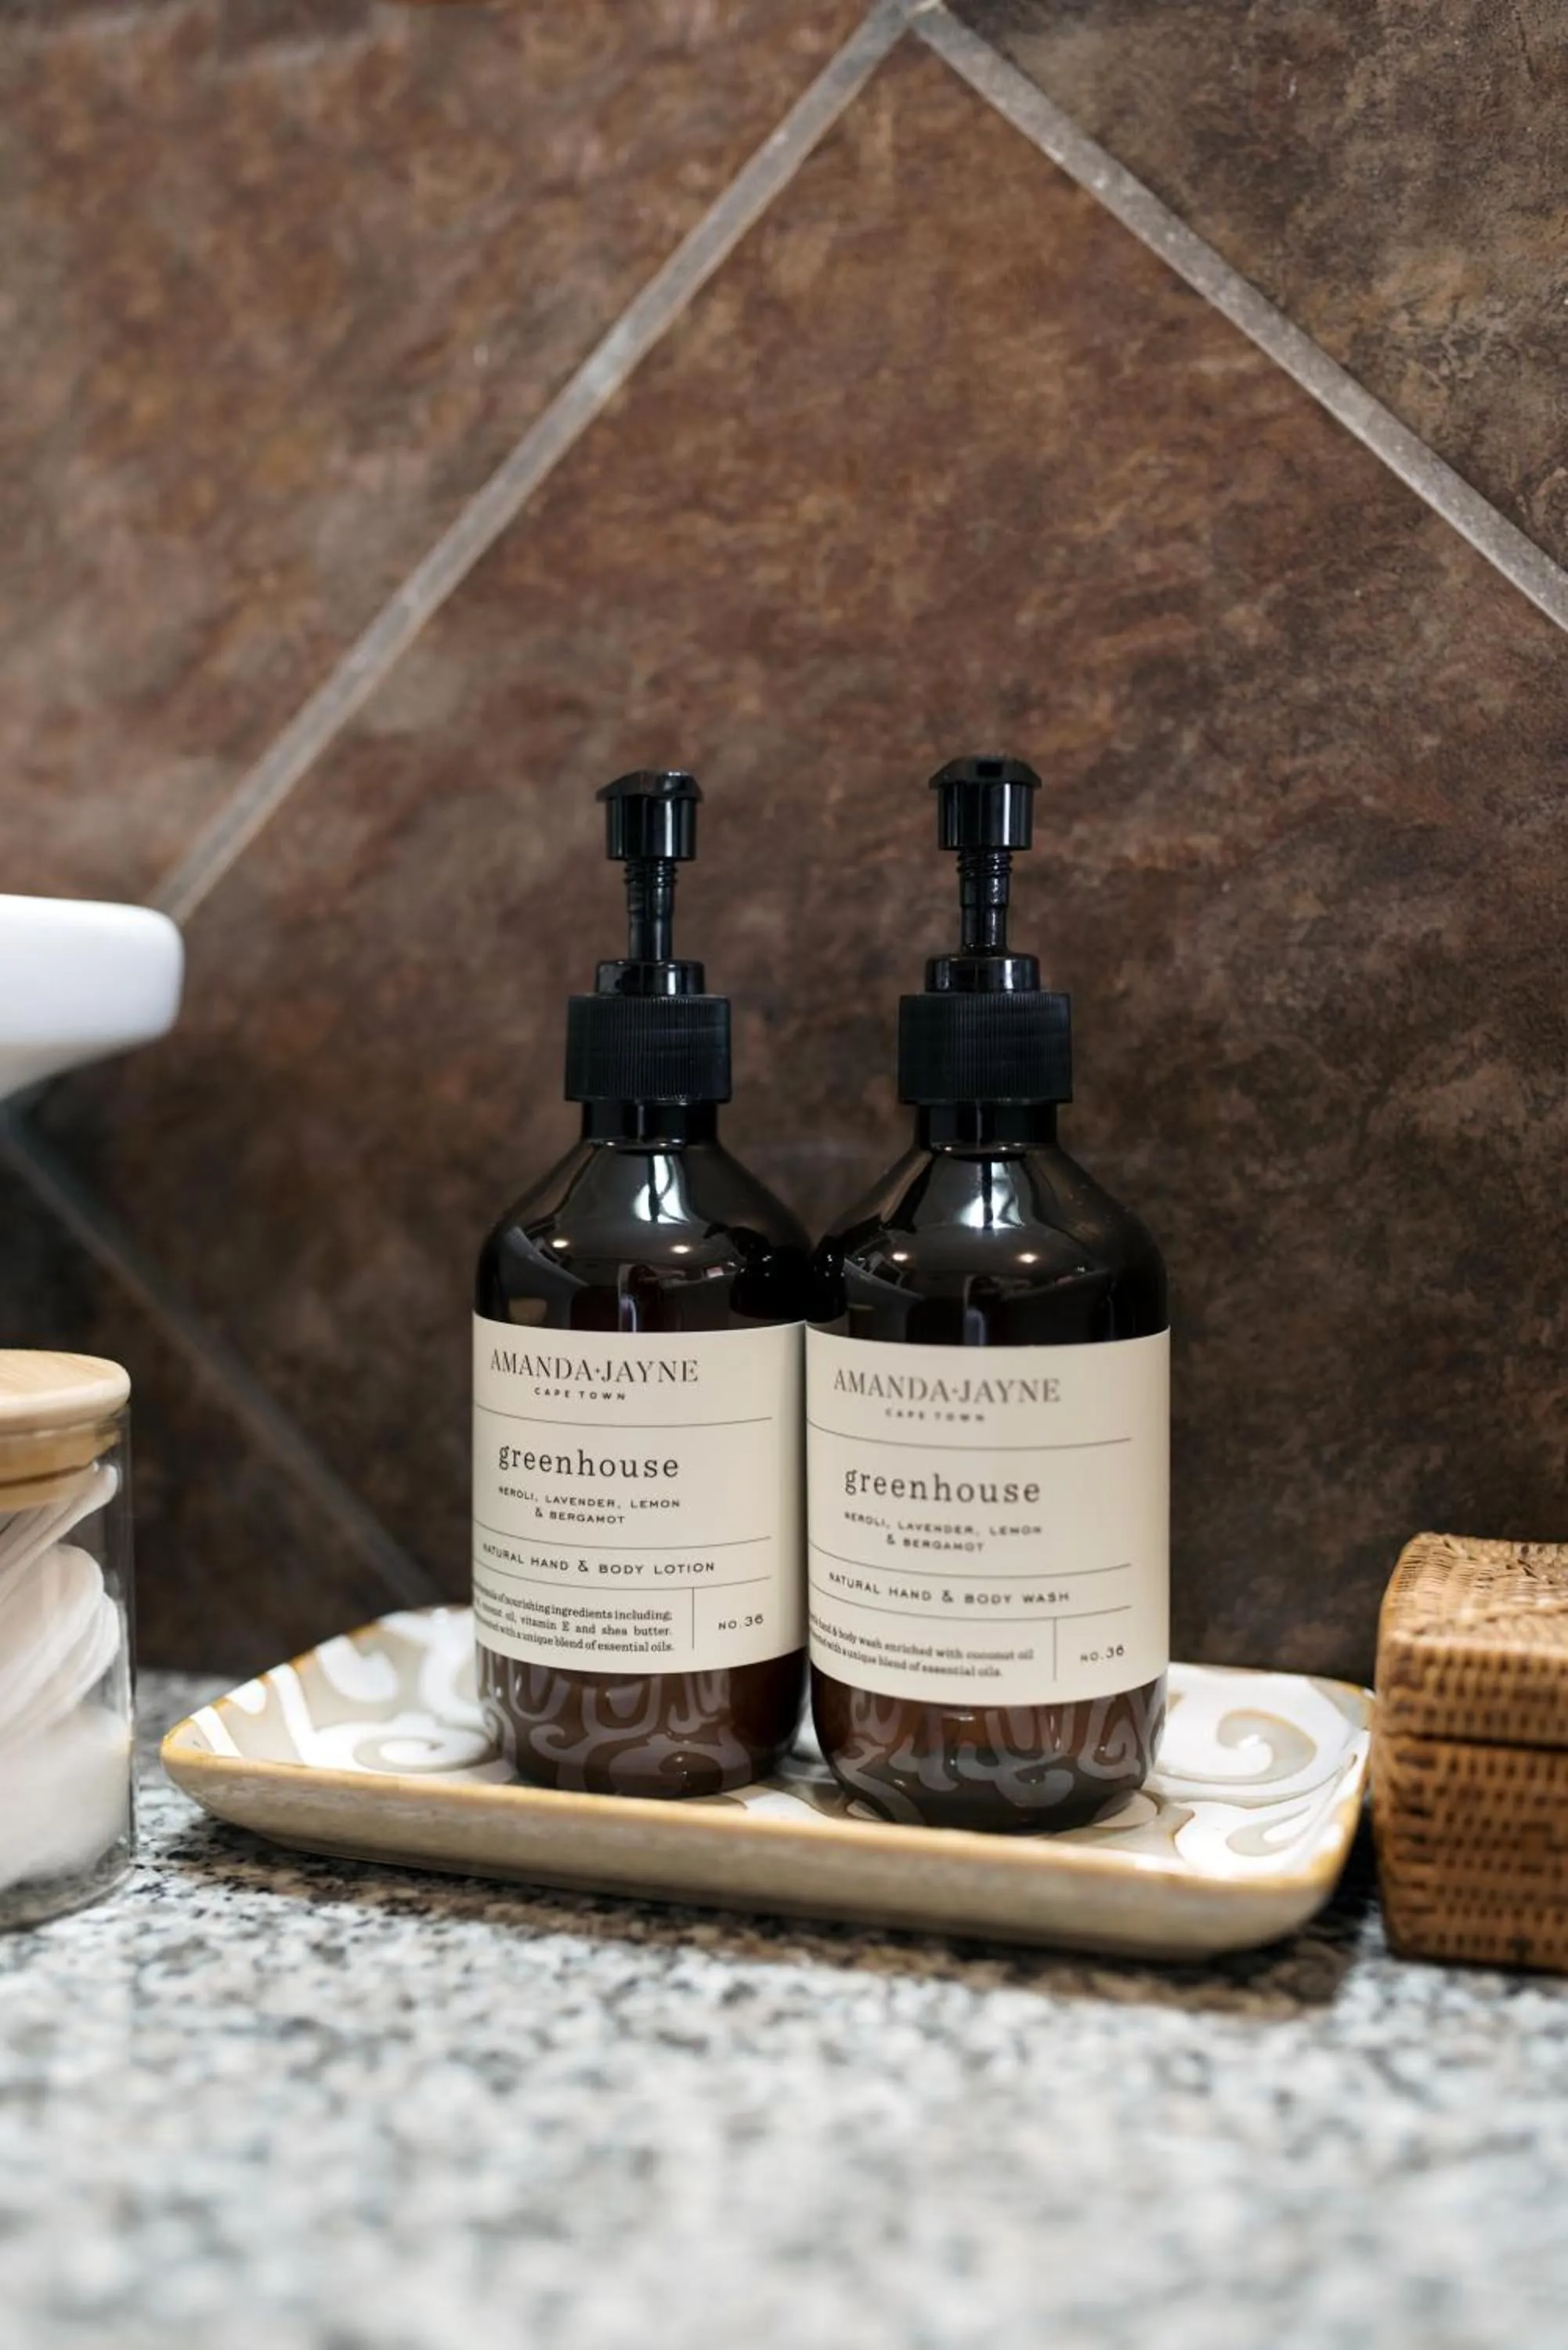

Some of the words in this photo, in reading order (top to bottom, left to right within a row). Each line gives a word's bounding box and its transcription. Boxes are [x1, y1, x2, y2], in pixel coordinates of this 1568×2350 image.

[534, 1386, 570, 1398] CAPE
[580, 1390, 626, 1401] TOWN
[498, 1445, 679, 1478] greenhouse
[844, 1469, 1042, 1504] greenhouse
[498, 1486, 538, 1502] NEROLI,
[545, 1495, 622, 1509] LAVENDER,
[630, 1499, 681, 1509] LEMON
[535, 1507, 543, 1518] &
[550, 1511, 626, 1524] BERGAMOT
[844, 1511, 891, 1529] NEROLI,
[898, 1520, 981, 1537] LAVENDER,
[989, 1526, 1042, 1536] LEMON
[886, 1534, 896, 1546] &
[903, 1538, 985, 1552] BERGAMOT
[482, 1542, 525, 1564] NATURAL
[530, 1556, 569, 1571] HAND
[577, 1560, 588, 1572] &
[599, 1564, 645, 1575] BODY
[654, 1562, 715, 1575] LOTION
[829, 1571, 880, 1595] NATURAL
[889, 1587, 932, 1602] HAND
[941, 1590, 954, 1603] &
[964, 1594, 1012, 1605] BODY
[1022, 1593, 1070, 1604] WASH
[551, 1603, 612, 1620] ingredients
[562, 1621, 570, 1632] E
[576, 1623, 596, 1634] and
[602, 1625, 627, 1636] shea
[555, 1635, 583, 1650] blend
[586, 1639, 597, 1650] of
[598, 1642, 649, 1653] essential
[936, 1647, 963, 1660] with
[1017, 1648, 1034, 1660] oil
[878, 1654, 906, 1670] blend
[909, 1660, 920, 1672] of
